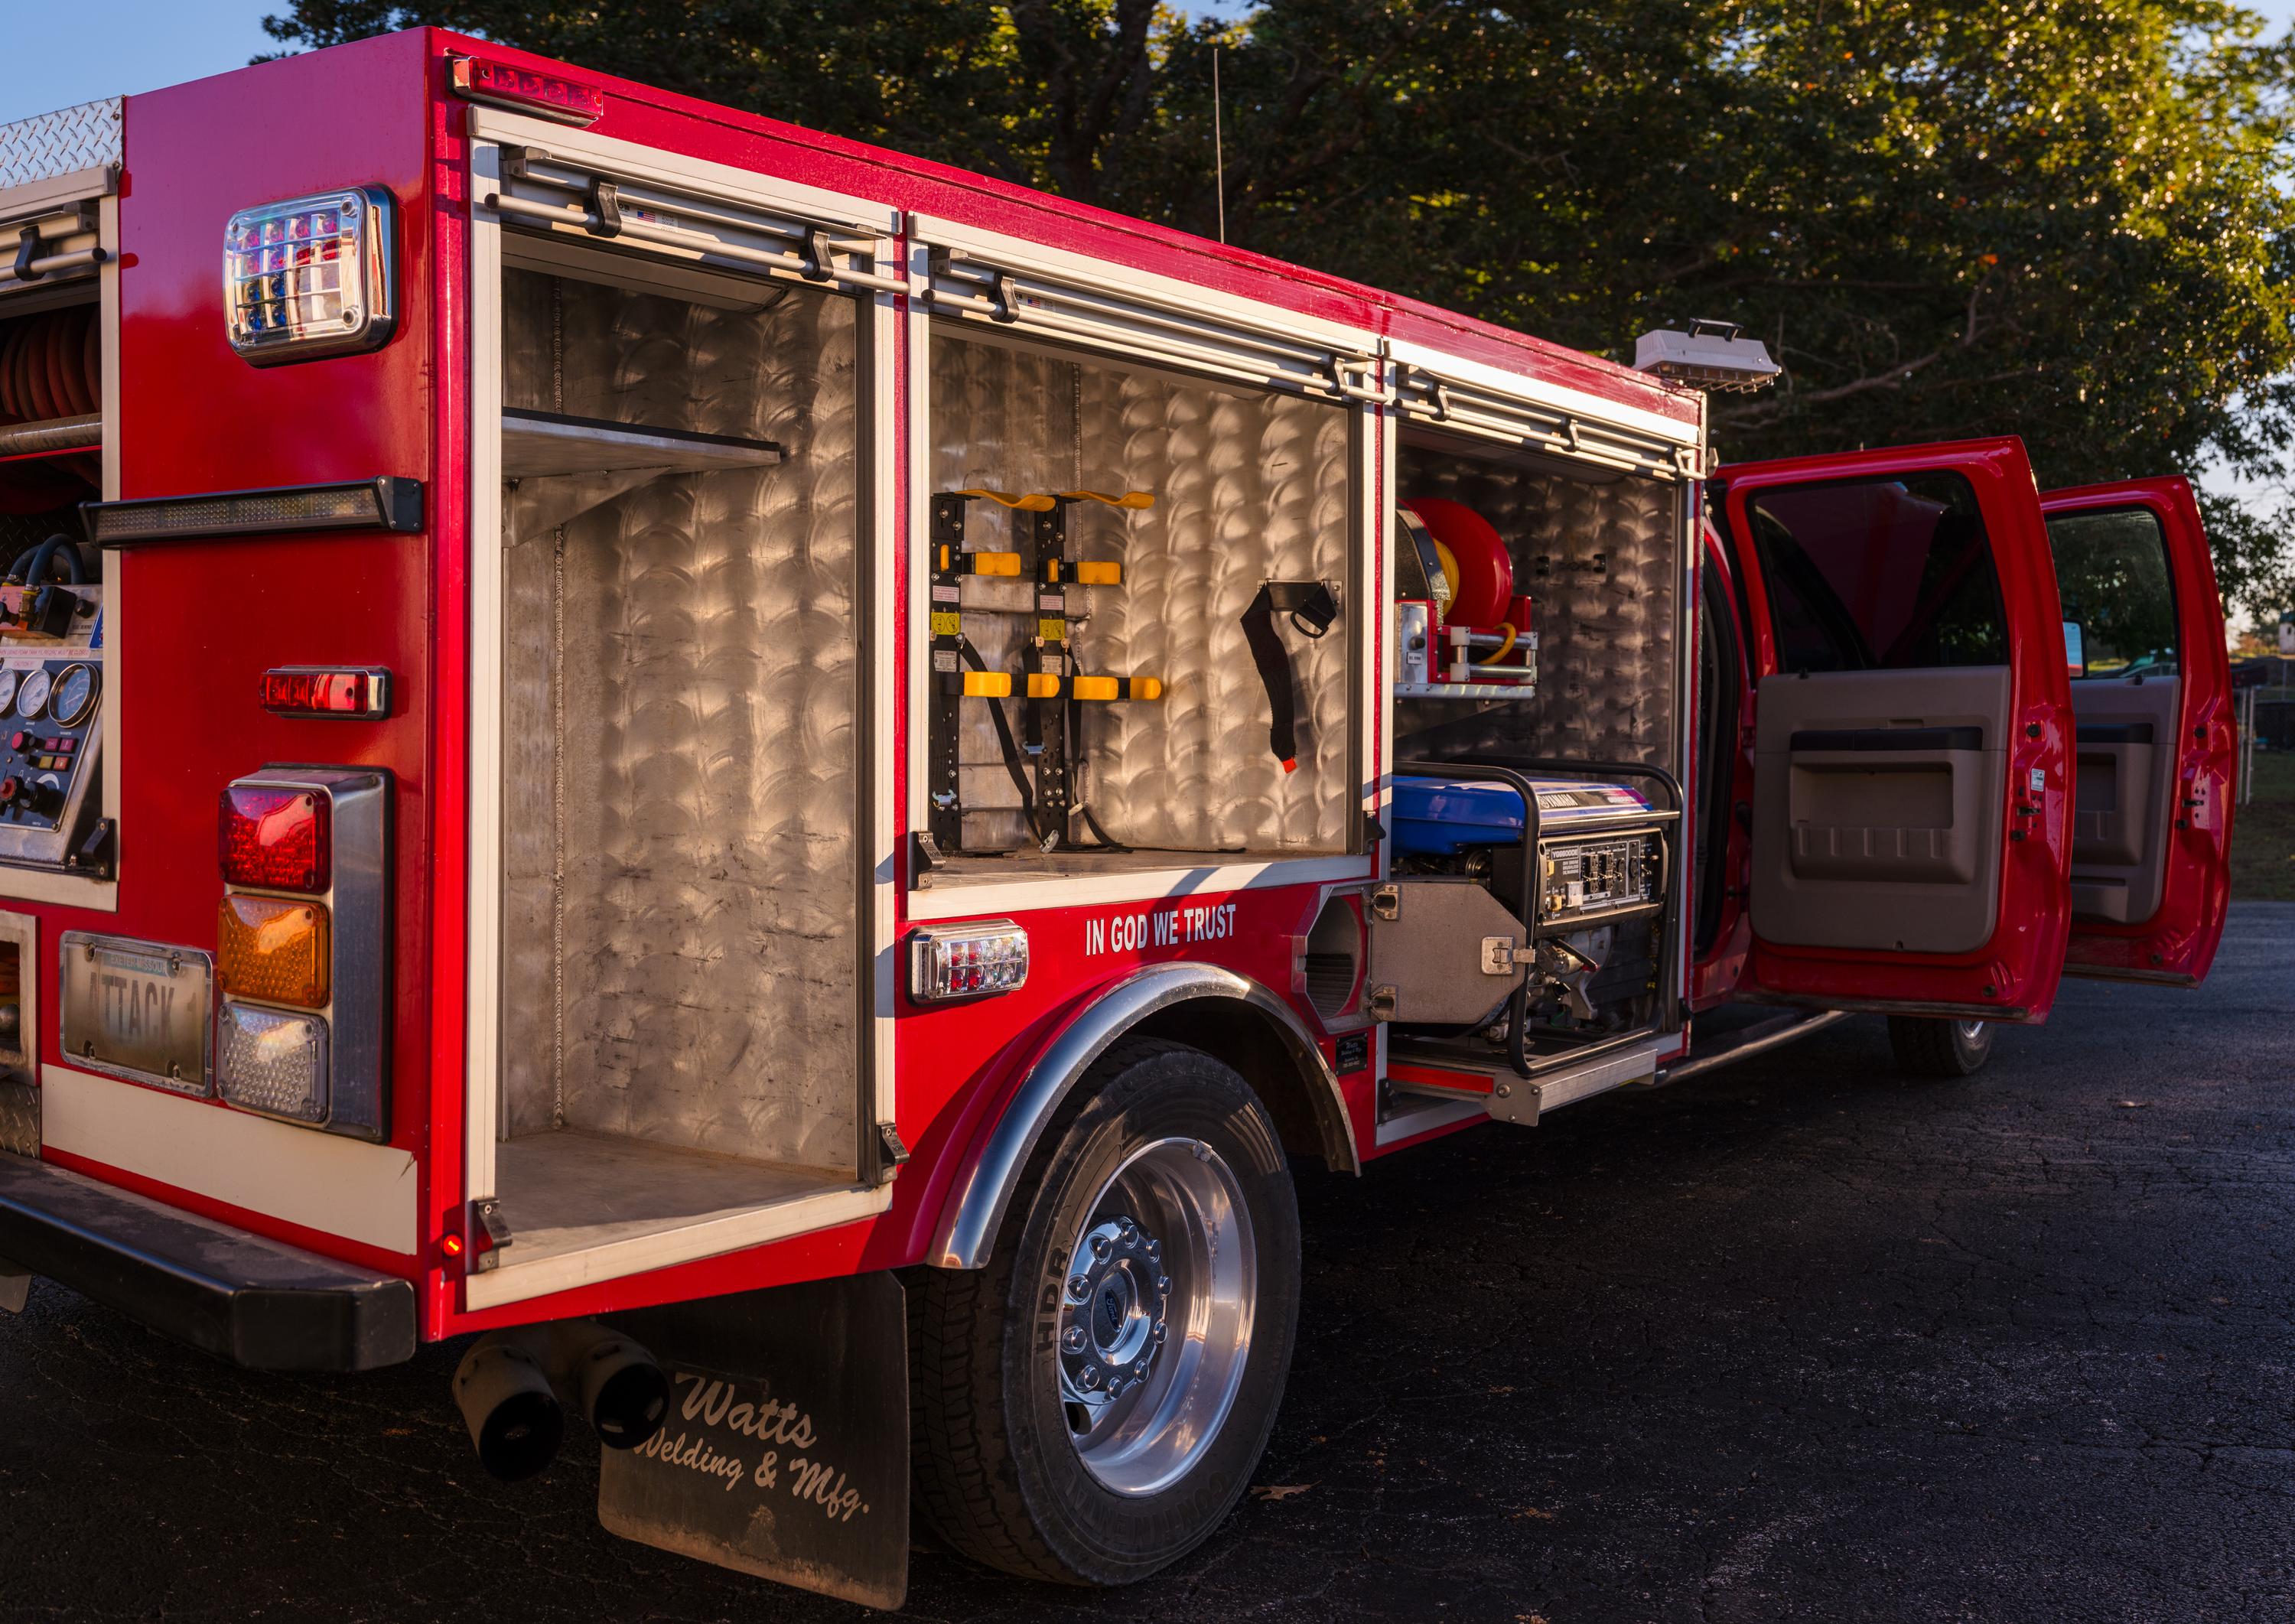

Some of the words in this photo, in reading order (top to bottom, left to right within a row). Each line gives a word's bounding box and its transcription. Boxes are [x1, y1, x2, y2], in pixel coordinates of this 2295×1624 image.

[1542, 793, 1578, 808] YAMAHA
[137, 956, 168, 974] MISSOUR
[1086, 919, 1105, 956] IN
[1111, 914, 1148, 953] GOD
[1154, 910, 1178, 947] WE
[1183, 903, 1236, 942] TRUST
[87, 971, 175, 1042] ATTACK
[1036, 1247, 1069, 1354] HDR
[675, 1372, 818, 1449] Watts
[754, 1450, 776, 1489] &
[789, 1457, 870, 1521] Mfg.
